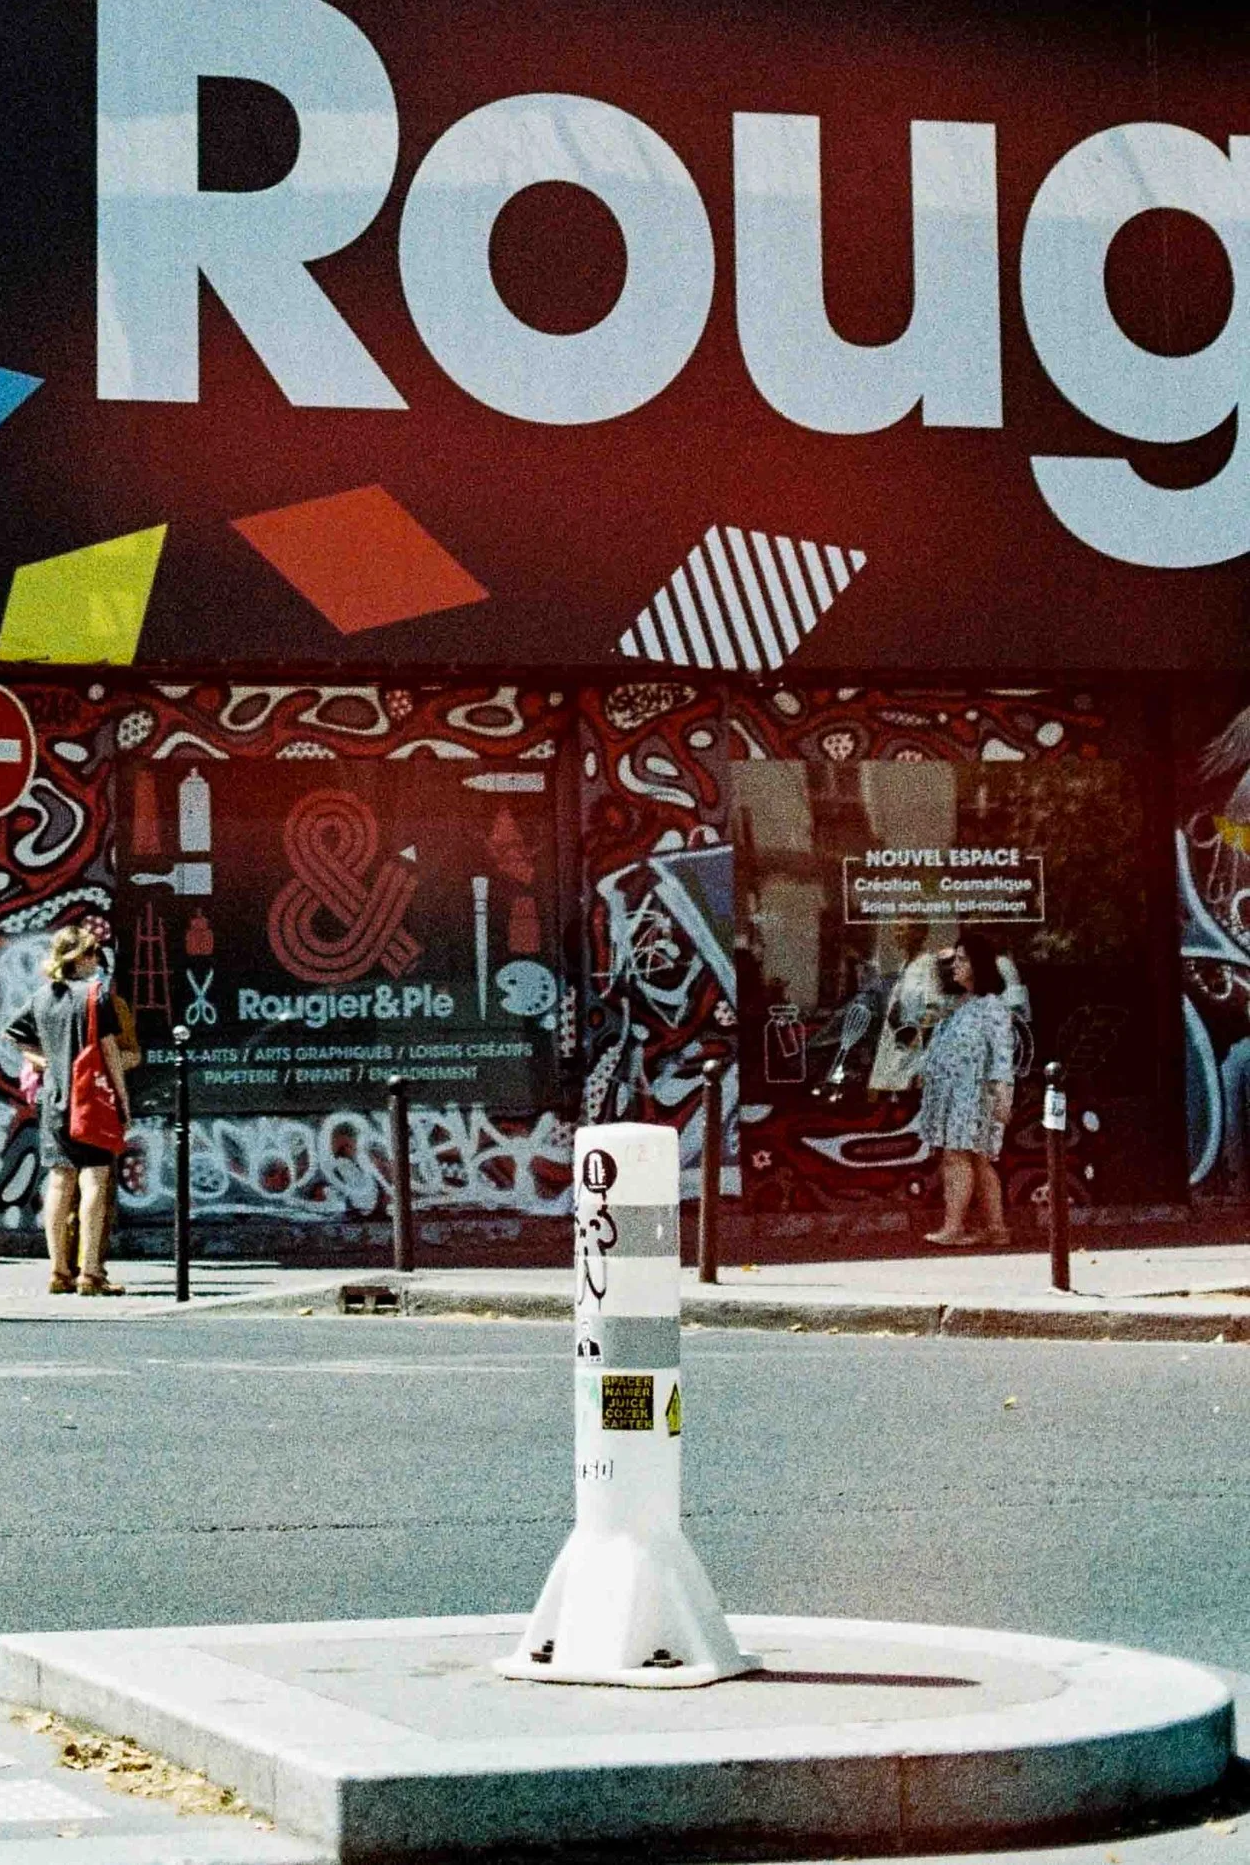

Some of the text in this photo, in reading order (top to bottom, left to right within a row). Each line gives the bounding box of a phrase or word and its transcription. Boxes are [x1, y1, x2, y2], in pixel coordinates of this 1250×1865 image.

[866, 847, 1020, 867] NOUVEL ESPACE
[855, 875, 922, 892] Création
[254, 1046, 291, 1061] ARTS
[295, 1044, 392, 1061] GRAPHIQUES
[408, 1044, 462, 1059] LOISIRS
[295, 1067, 351, 1083] ENFANT
[608, 1398, 646, 1408] JUICE
